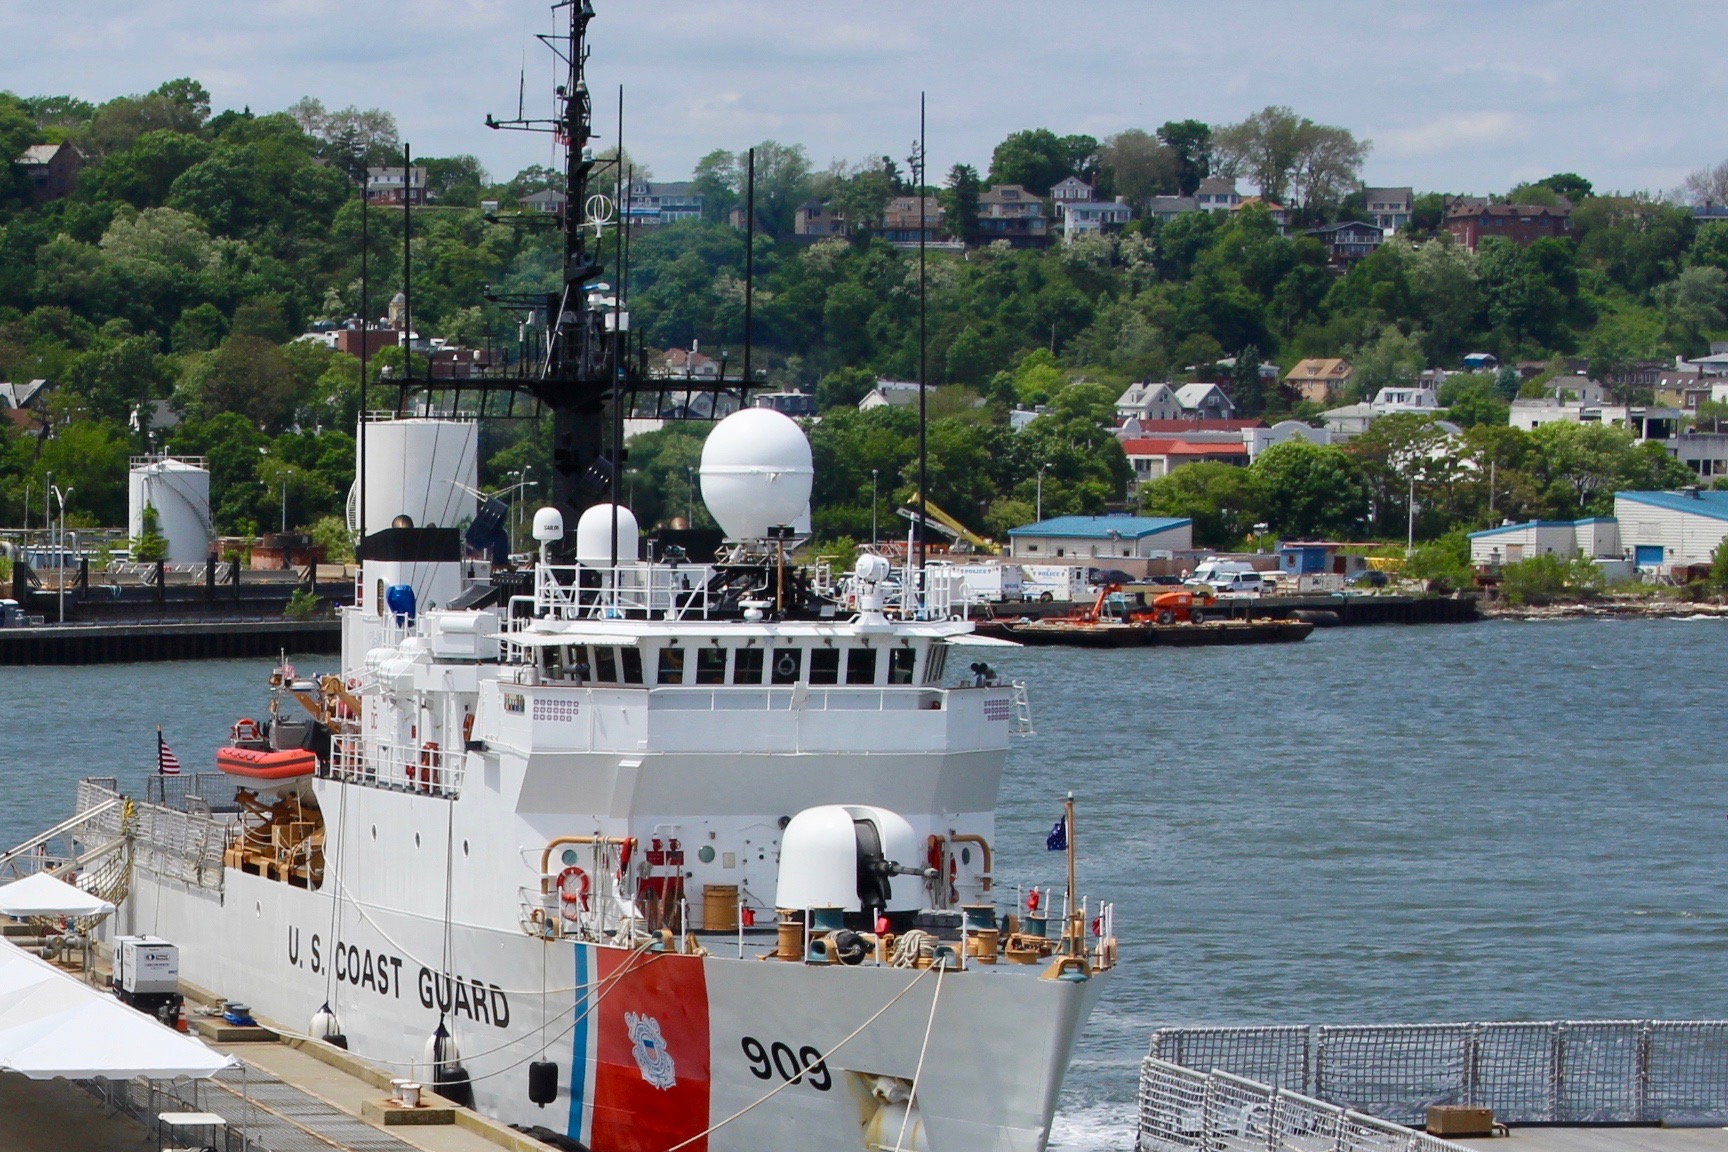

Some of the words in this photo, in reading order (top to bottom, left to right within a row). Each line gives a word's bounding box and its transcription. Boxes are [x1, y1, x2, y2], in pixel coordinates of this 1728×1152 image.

[288, 924, 303, 969] U.
[311, 933, 325, 976] S.
[335, 941, 403, 999] COAST
[418, 966, 510, 1029] GUARD
[741, 1036, 832, 1091] 909
